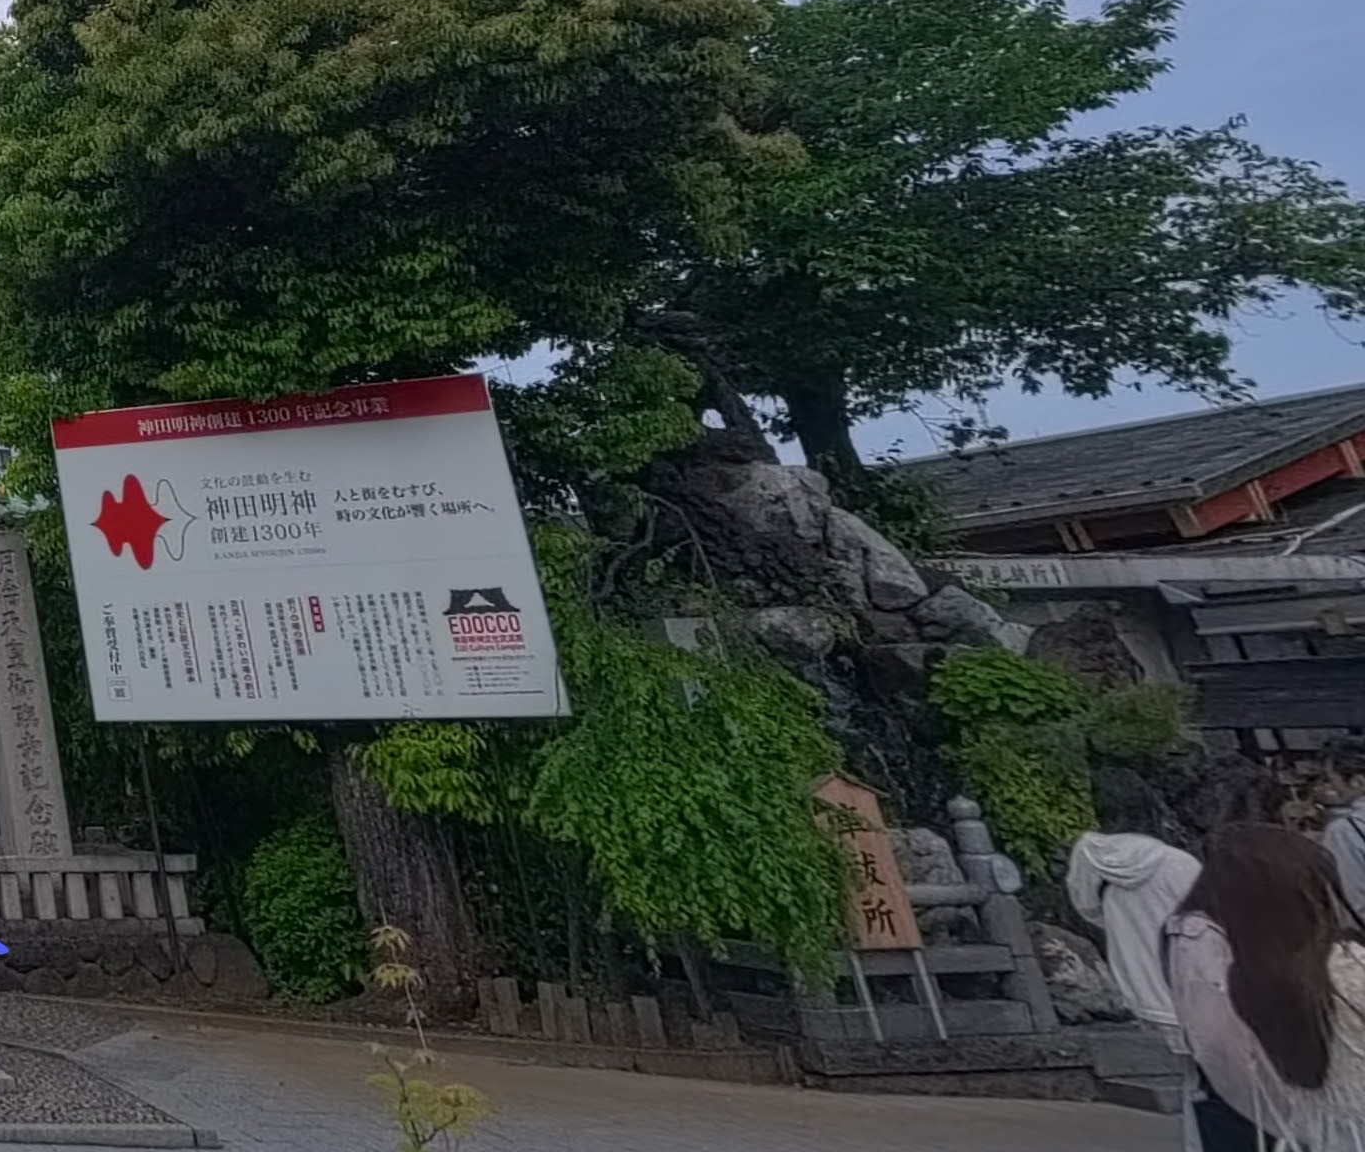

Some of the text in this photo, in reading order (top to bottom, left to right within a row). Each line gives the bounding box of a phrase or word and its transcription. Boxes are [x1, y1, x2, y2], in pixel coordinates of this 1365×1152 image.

[248, 407, 291, 426] 1300
[296, 397, 390, 422] 年記念事業
[200, 470, 312, 490] 文化の鼓動を生む
[333, 481, 445, 503] 人と街をむすび、
[205, 489, 317, 521] 神田明神
[210, 521, 323, 545] 創建1300年
[448, 614, 521, 635] EDOCCO
